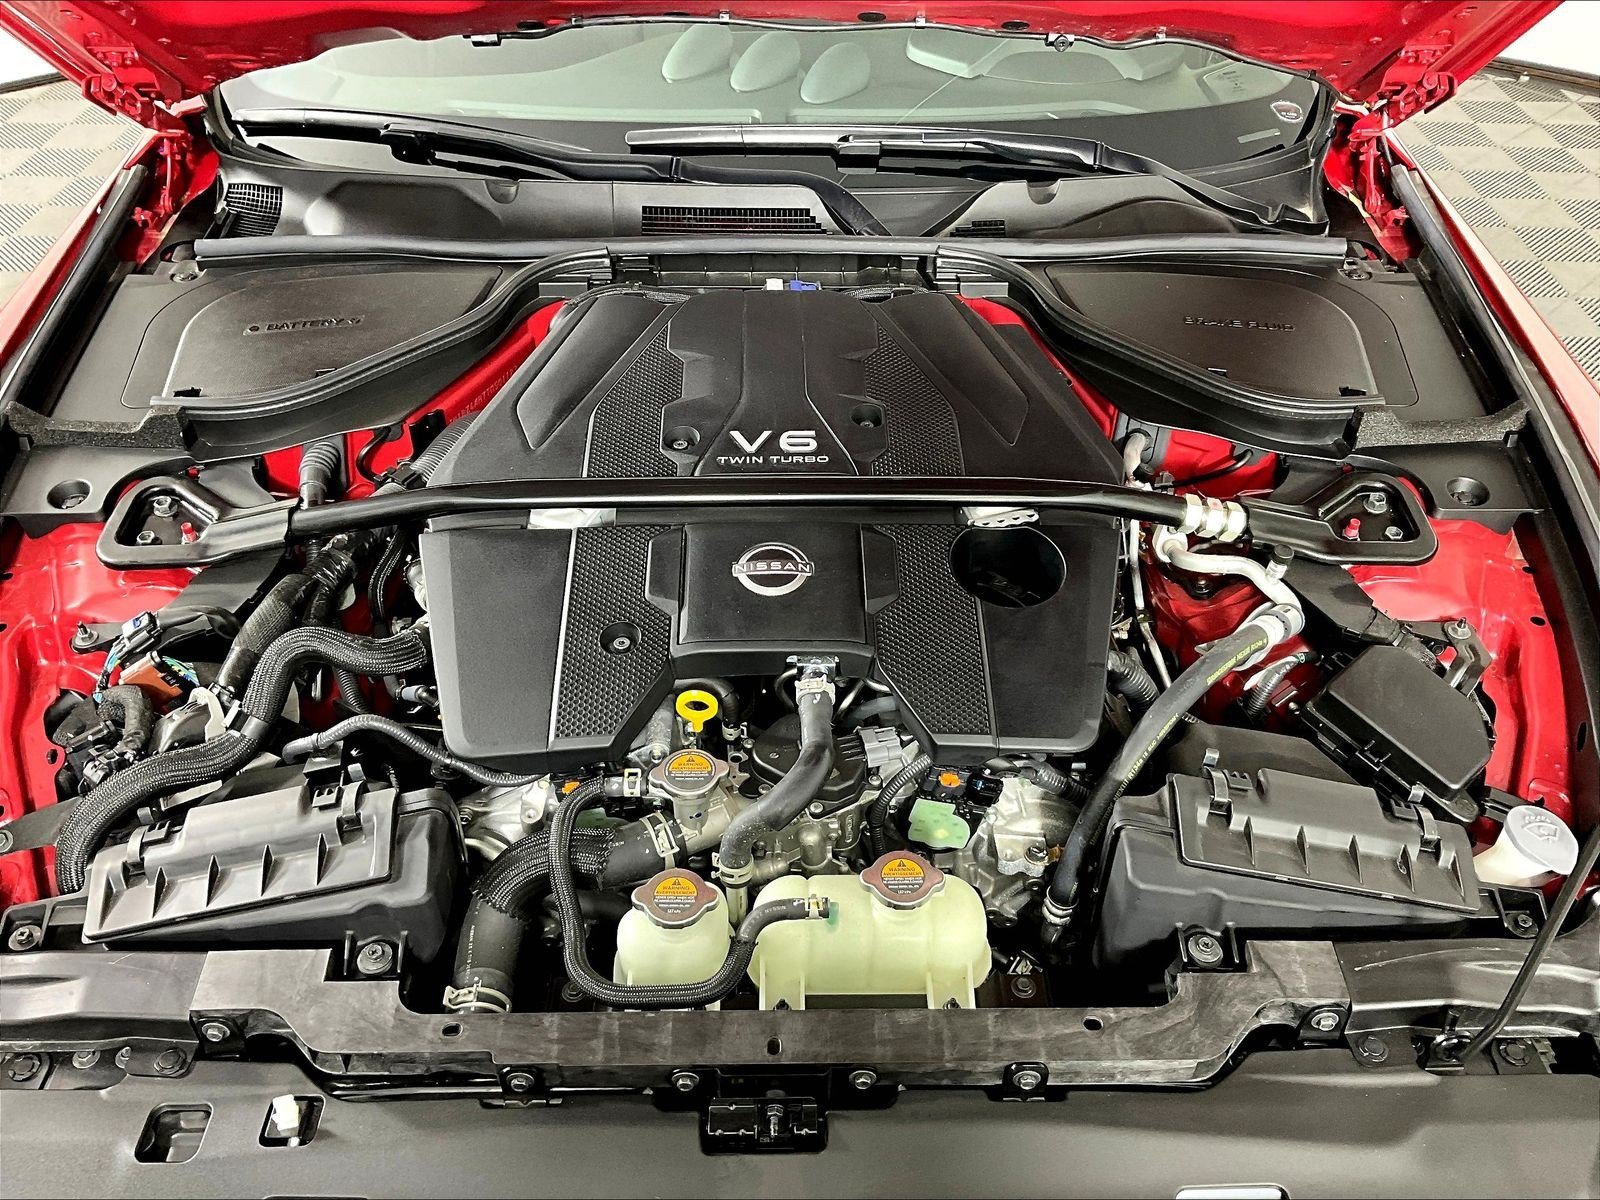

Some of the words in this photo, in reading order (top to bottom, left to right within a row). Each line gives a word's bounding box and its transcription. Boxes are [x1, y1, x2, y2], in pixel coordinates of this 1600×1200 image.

[266, 318, 344, 331] BATTERY
[729, 430, 818, 454] V6
[717, 456, 764, 465] TWIN
[769, 455, 830, 464] TURBO
[735, 561, 811, 574] NISSAN
